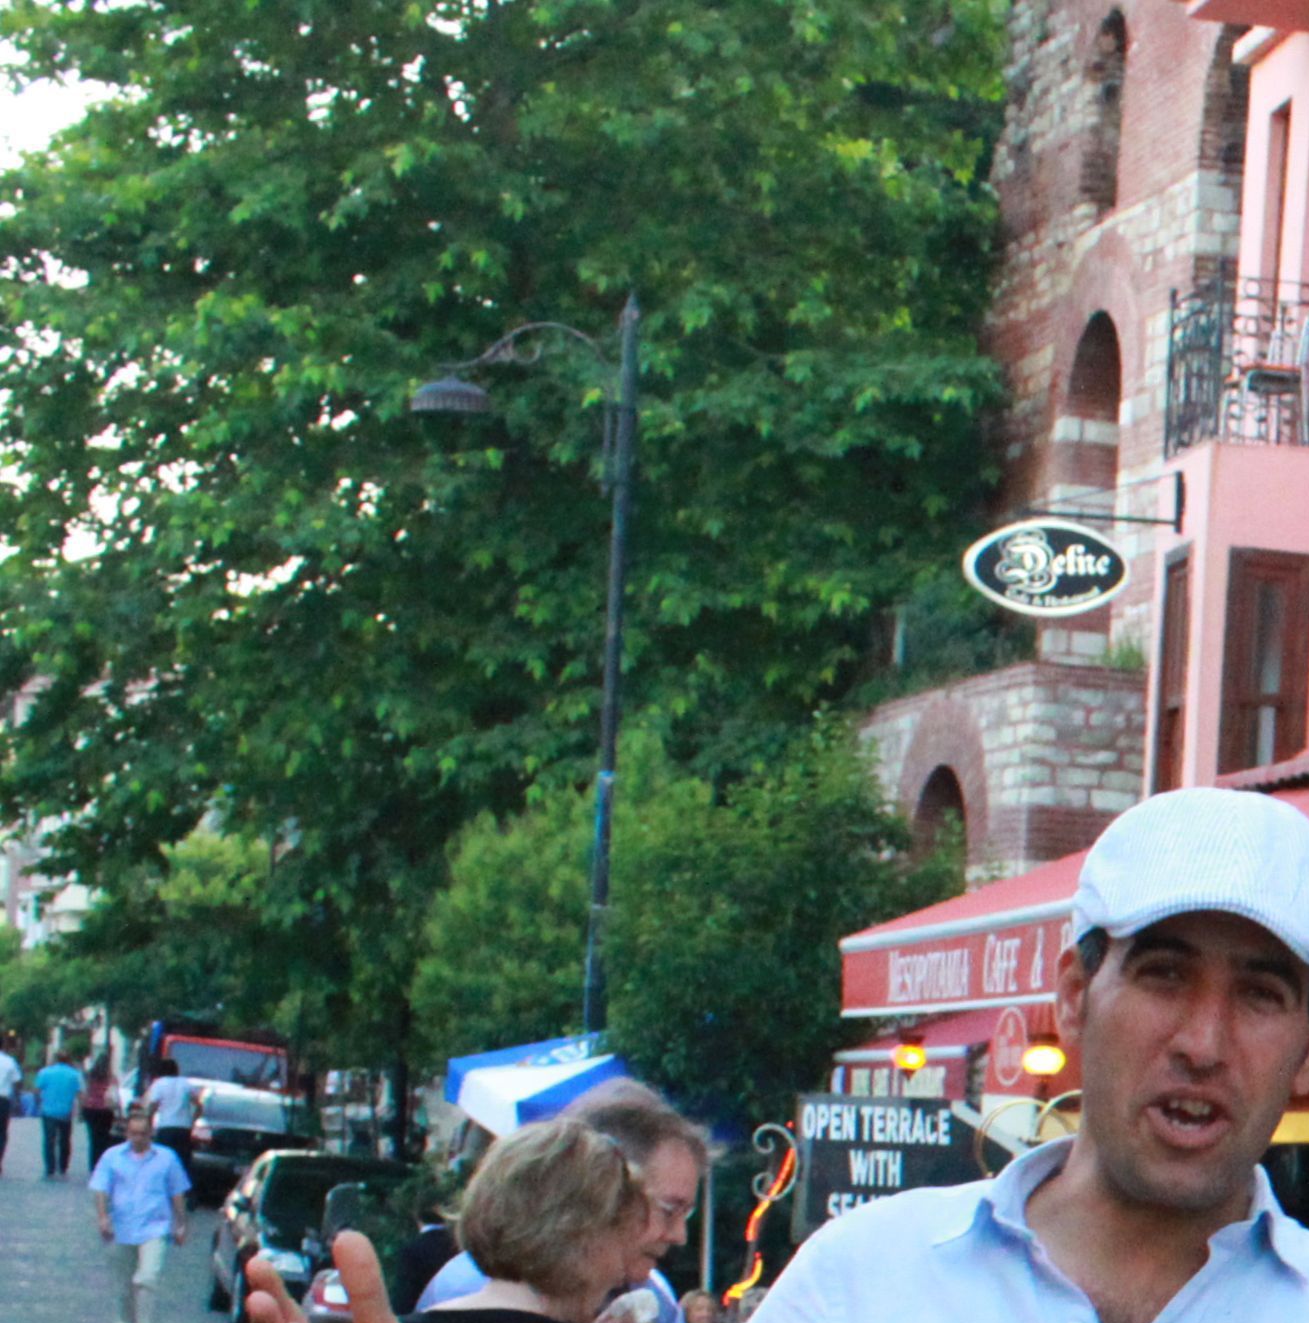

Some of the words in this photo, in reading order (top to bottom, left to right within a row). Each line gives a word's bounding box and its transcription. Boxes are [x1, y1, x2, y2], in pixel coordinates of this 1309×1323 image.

[801, 1103, 858, 1142] OPEN
[860, 1105, 951, 1146] TERRACE
[849, 1150, 903, 1187] WITH
